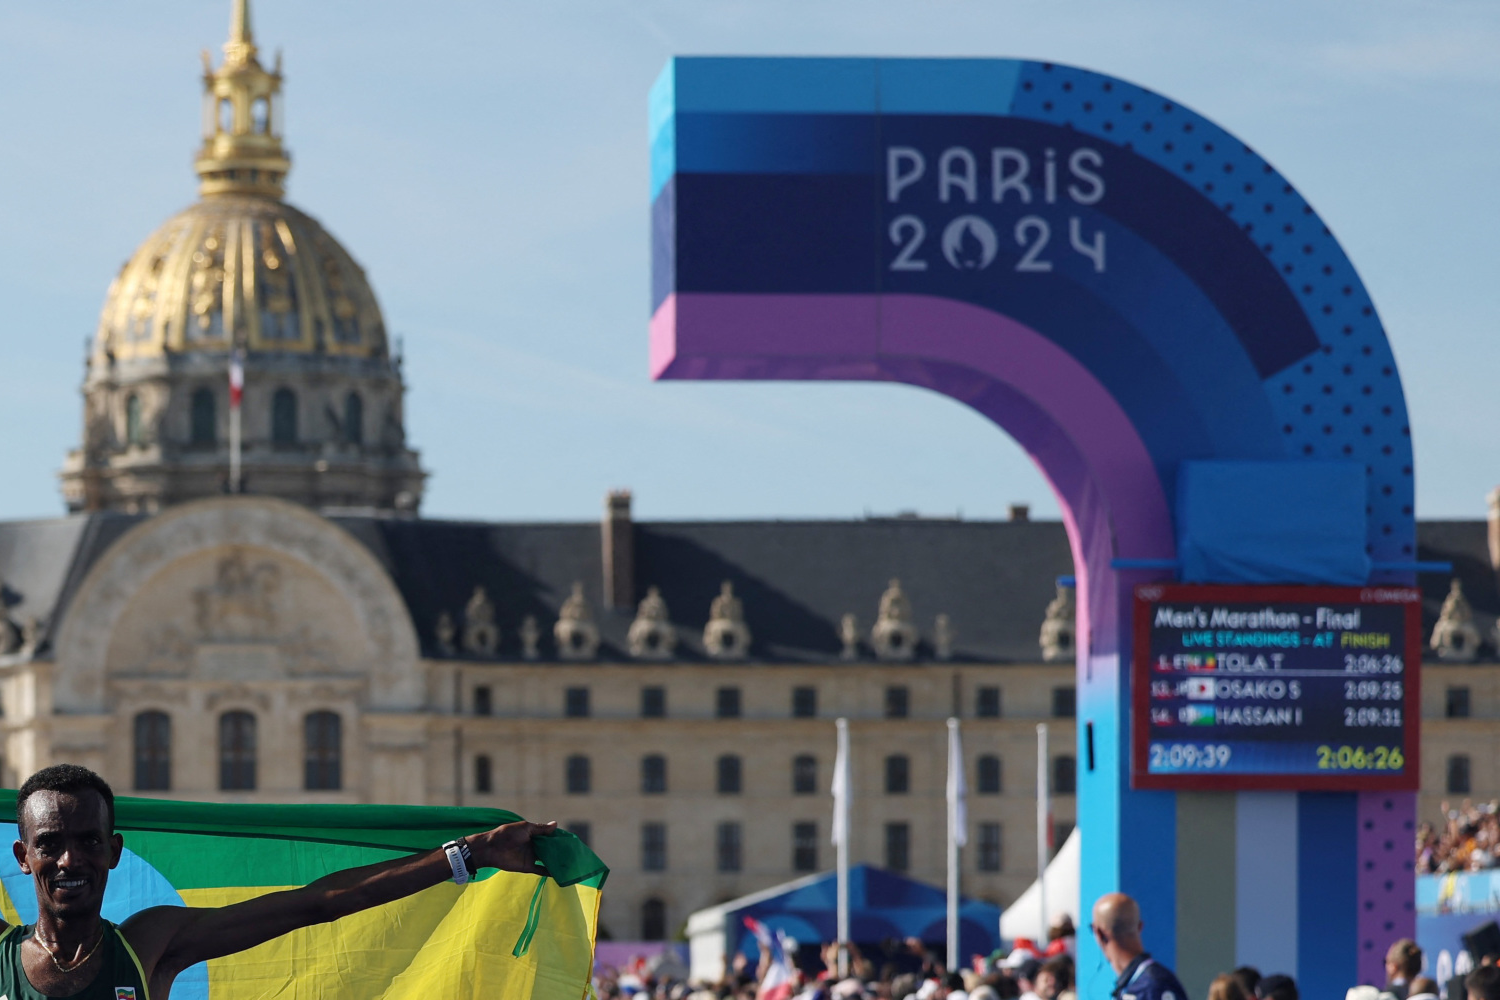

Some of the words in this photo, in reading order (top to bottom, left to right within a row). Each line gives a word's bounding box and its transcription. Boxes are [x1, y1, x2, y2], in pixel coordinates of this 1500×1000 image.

[888, 215, 1107, 273] 2024
[1155, 608, 1208, 630] Men's
[1211, 608, 1300, 630] Marathon
[1316, 608, 1360, 630] Final
[1182, 631, 1213, 648] LIVE
[1216, 631, 1301, 648] STANDINGS
[1312, 631, 1334, 648] AT
[1340, 631, 1391, 649] FINISH
[1217, 653, 1268, 673] TOLA
[1271, 653, 1285, 671] T
[1344, 653, 1404, 674] 2:06:26
[1215, 679, 1287, 700] OSAKO
[1289, 679, 1302, 700] S
[1216, 705, 1291, 726] HASSAN
[1294, 706, 1303, 726] I
[1150, 744, 1232, 769] 2:09:39
[1316, 745, 1405, 770] 2:06:26
